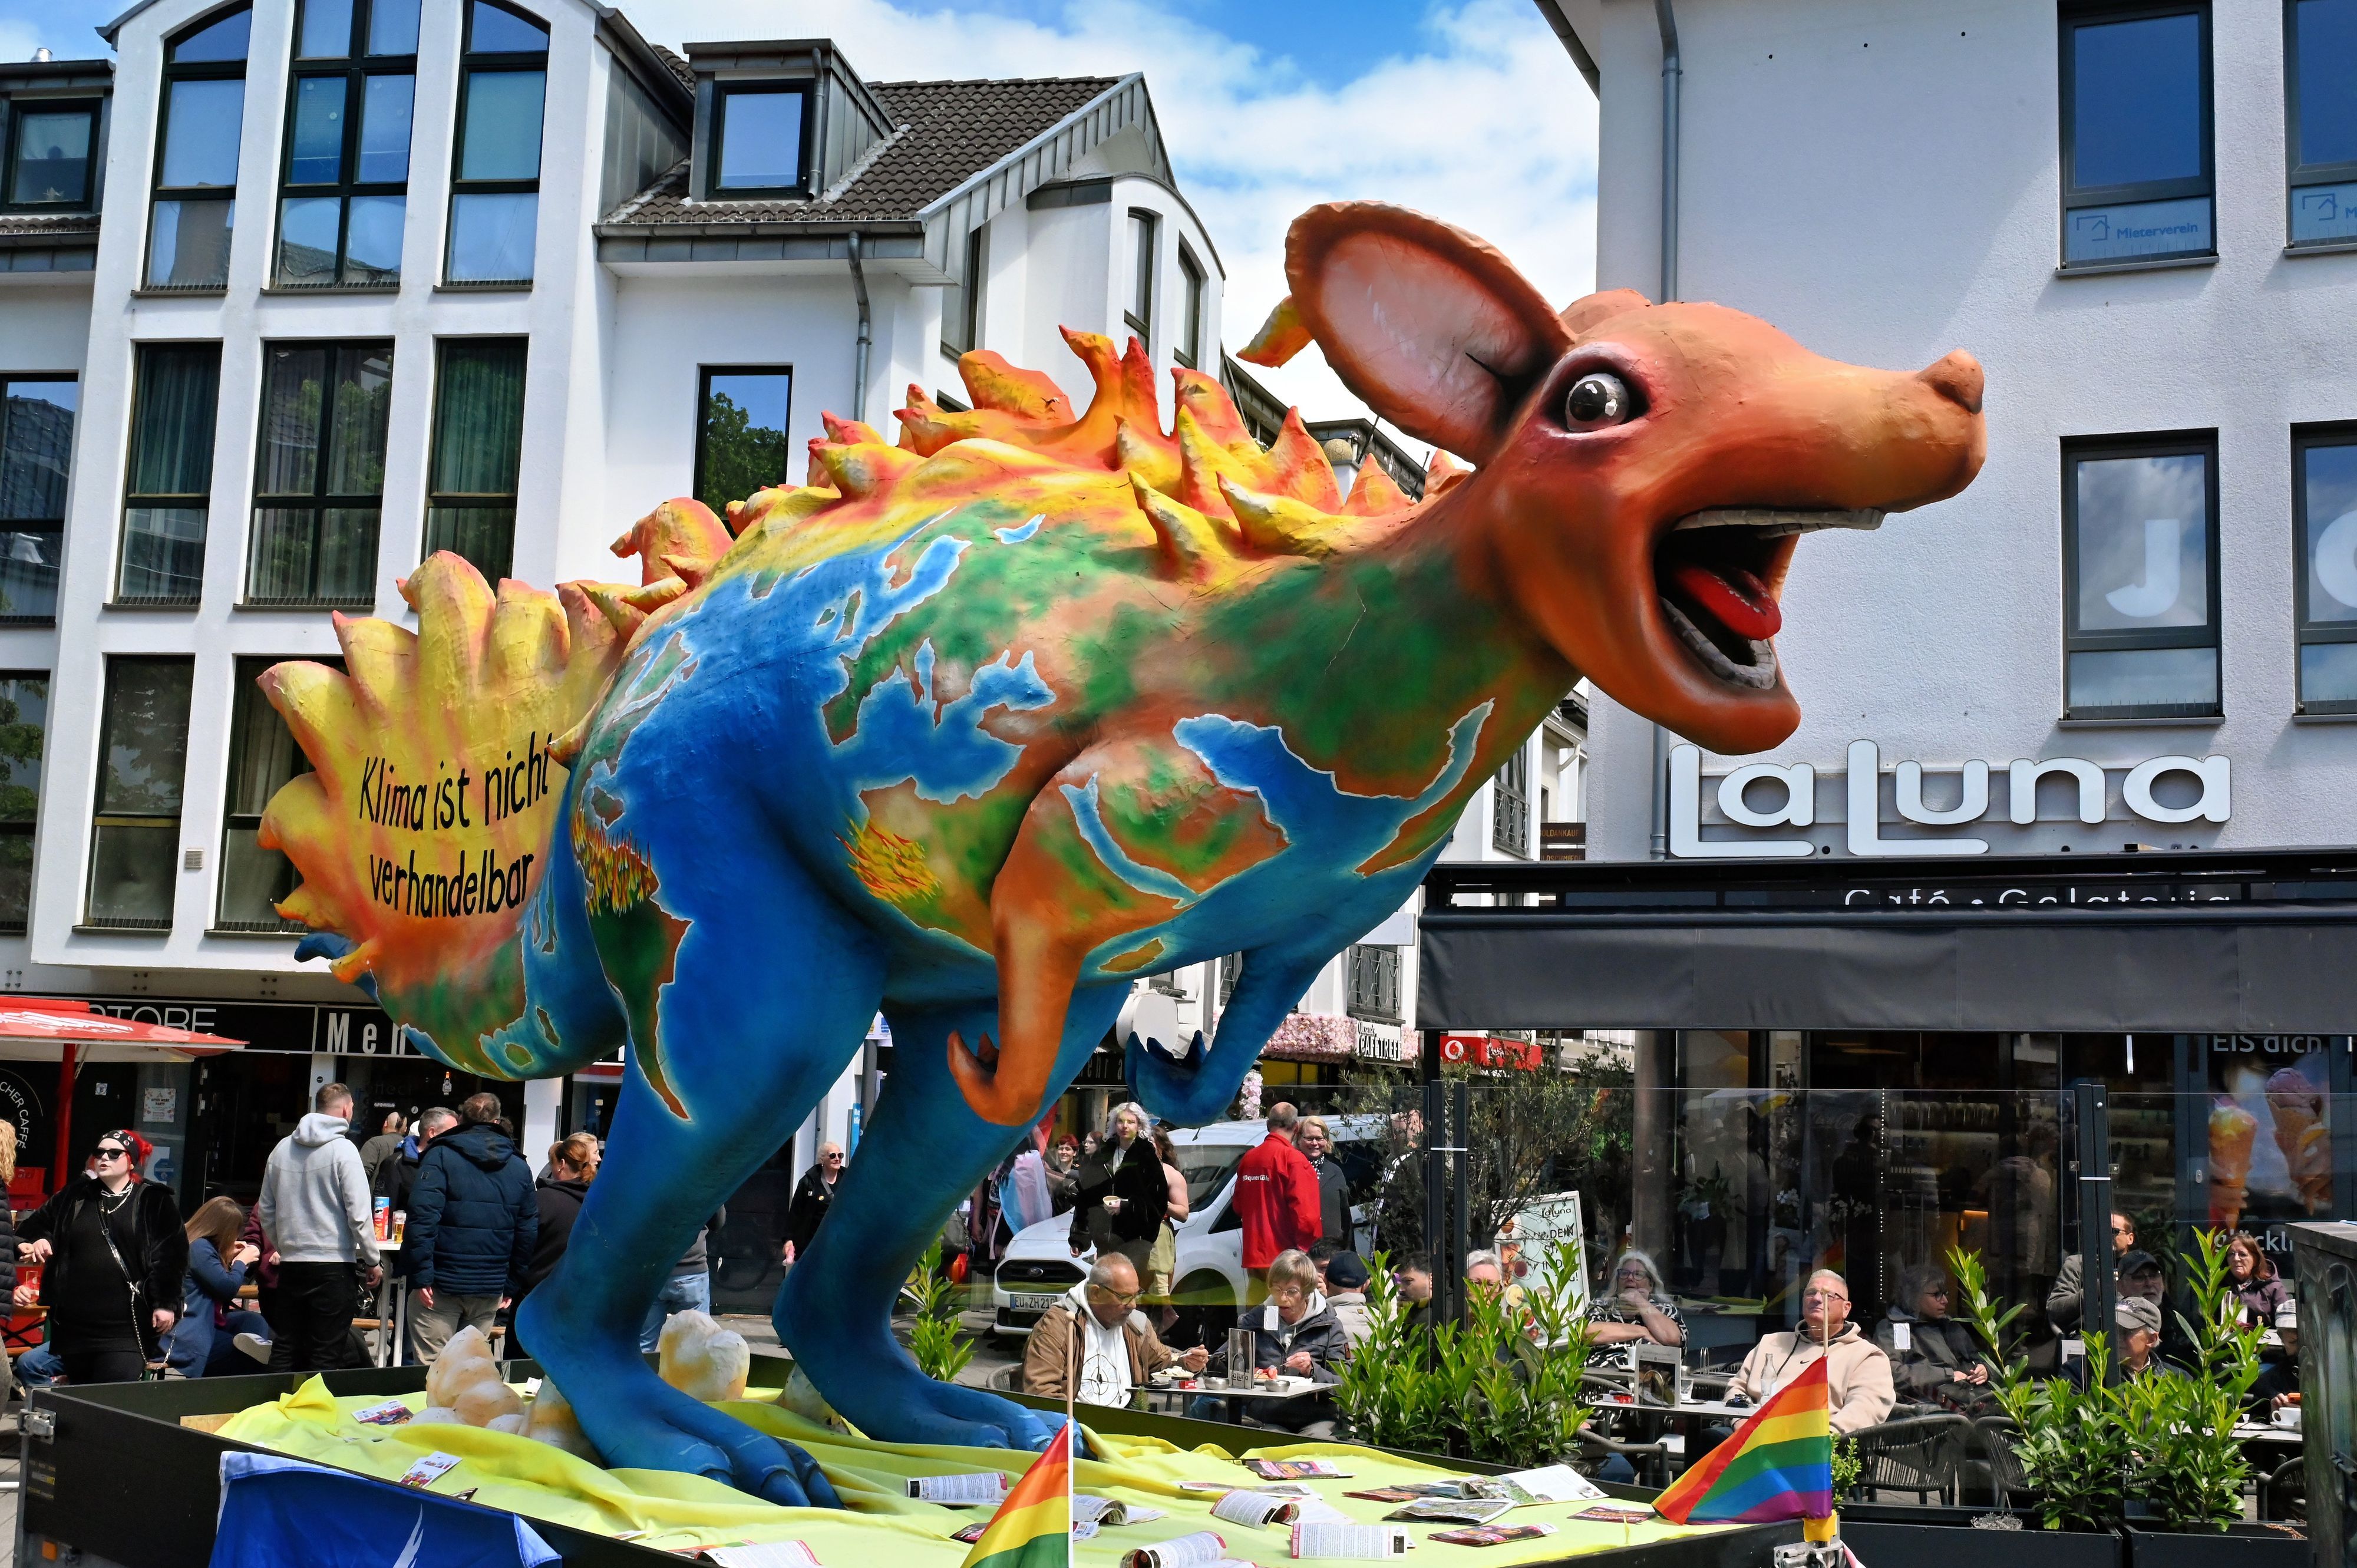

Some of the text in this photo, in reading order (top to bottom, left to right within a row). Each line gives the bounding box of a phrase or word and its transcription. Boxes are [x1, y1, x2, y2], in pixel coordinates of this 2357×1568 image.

[2117, 222, 2199, 240] Mieterverein
[2105, 519, 2180, 618] J
[359, 731, 553, 831] Klima ist nicht
[1540, 829, 1580, 837] OLDANKAUF
[369, 849, 534, 919] verhandelbar
[90, 1004, 217, 1032] TORE
[327, 1012, 406, 1055] Men
[2263, 1035, 2322, 1053] dich
[1015, 1296, 1025, 1308] EU
[1029, 1297, 1039, 1308] ZH
